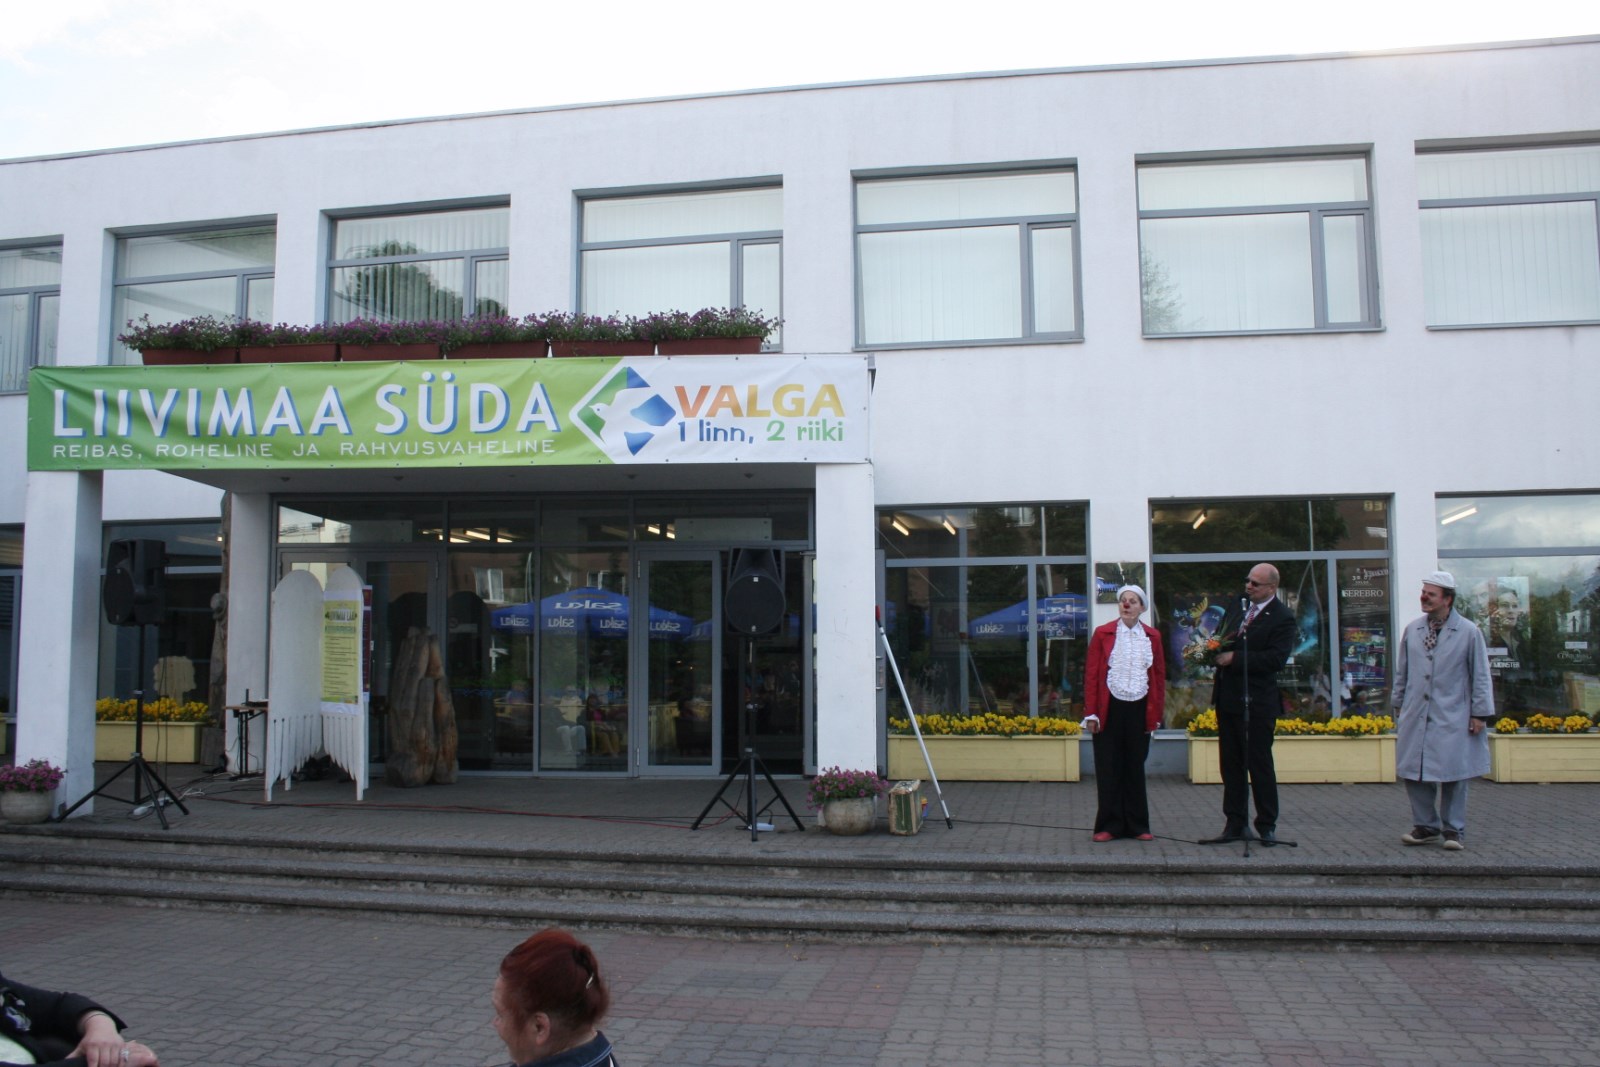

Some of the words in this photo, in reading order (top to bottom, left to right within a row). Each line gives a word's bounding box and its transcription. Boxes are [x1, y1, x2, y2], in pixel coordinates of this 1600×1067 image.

[53, 384, 353, 439] LIIVIMAA
[375, 371, 562, 435] SÜDA
[674, 383, 846, 418] VALGA
[678, 421, 686, 442] 1
[700, 420, 754, 445] linn,
[766, 420, 786, 442] 2
[797, 420, 844, 442] riiki
[53, 443, 143, 460] REIBAS,
[156, 443, 274, 458] ROHELINE
[293, 442, 320, 456] JA
[340, 439, 555, 456] RAHVUSVAHELINE
[1344, 589, 1384, 597] SEREBRO
